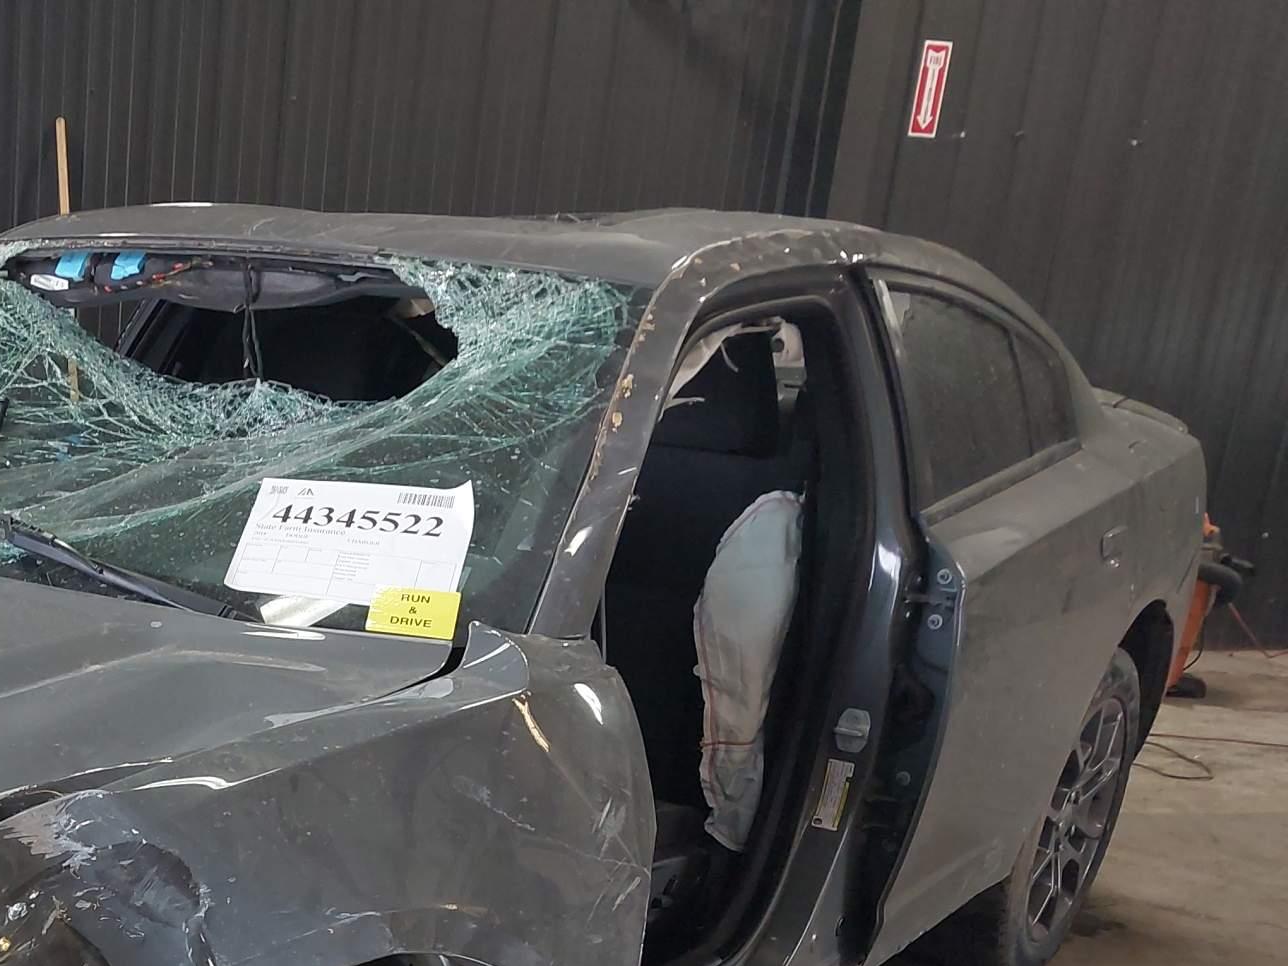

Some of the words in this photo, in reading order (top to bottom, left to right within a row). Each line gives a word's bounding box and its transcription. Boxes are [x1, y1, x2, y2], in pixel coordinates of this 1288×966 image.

[255, 522, 277, 530] State
[272, 503, 444, 538] 44345522
[400, 593, 431, 604] RUN
[408, 606, 417, 615] &
[389, 615, 433, 628] DRIVE
